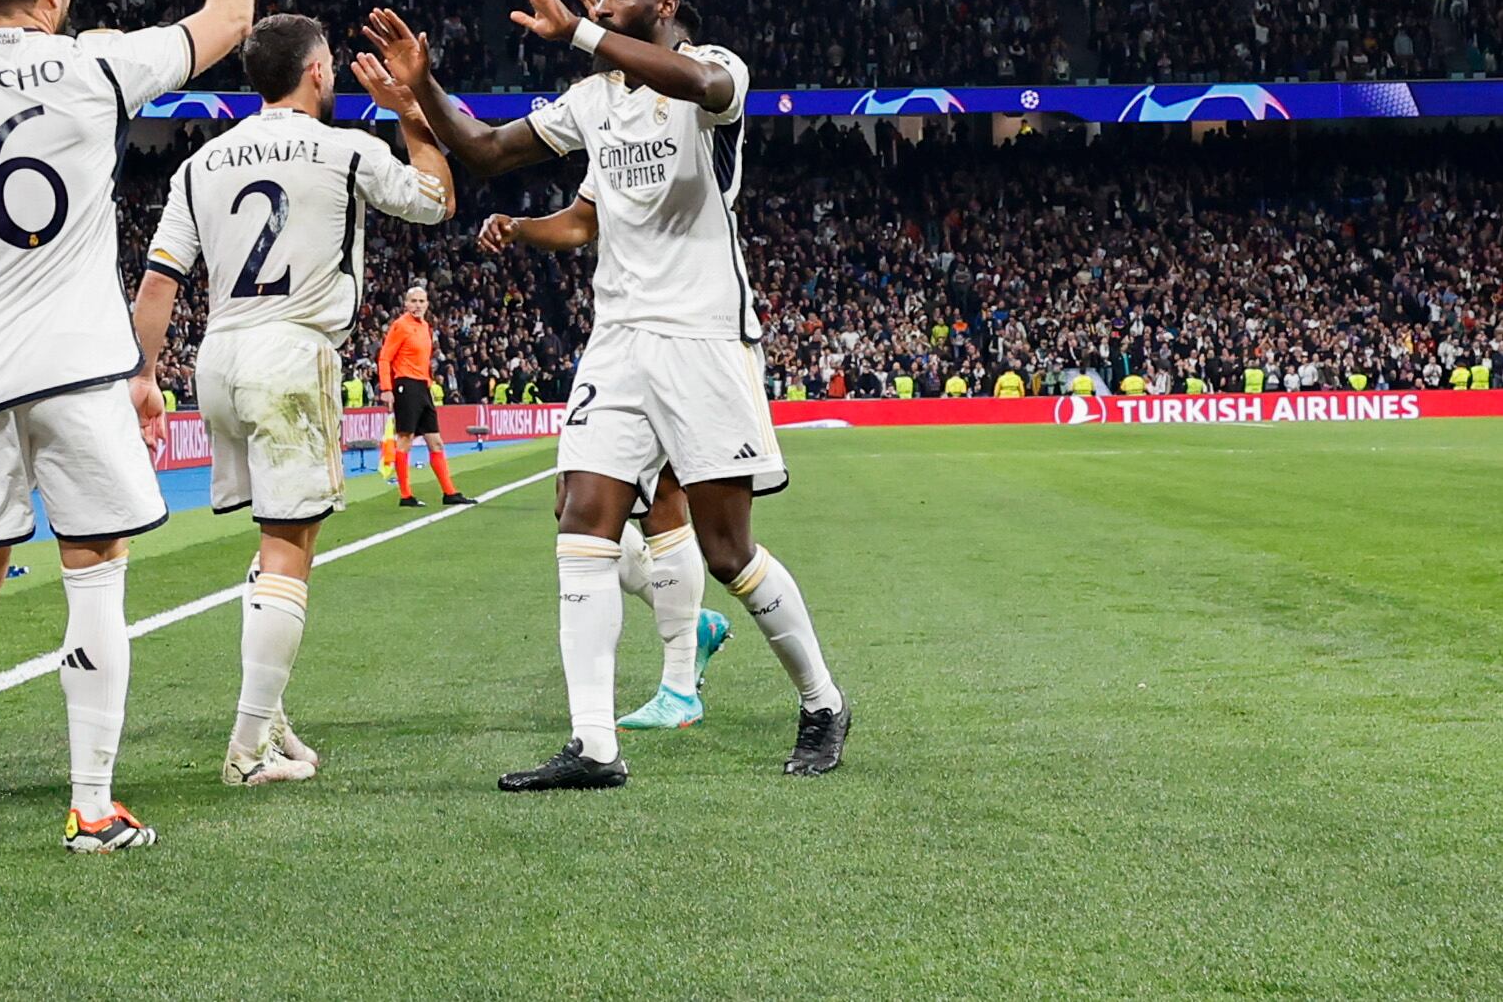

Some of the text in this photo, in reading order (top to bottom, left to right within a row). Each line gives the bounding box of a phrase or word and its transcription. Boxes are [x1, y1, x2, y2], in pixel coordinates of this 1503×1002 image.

[206, 140, 326, 172] CARVAJAL
[599, 136, 678, 169] Emirates
[627, 163, 667, 188] BETTER
[230, 179, 291, 298] 2
[566, 382, 597, 426] 2
[1117, 394, 1421, 423] TURKISH AIRLINES
[490, 409, 533, 436] TURKISH
